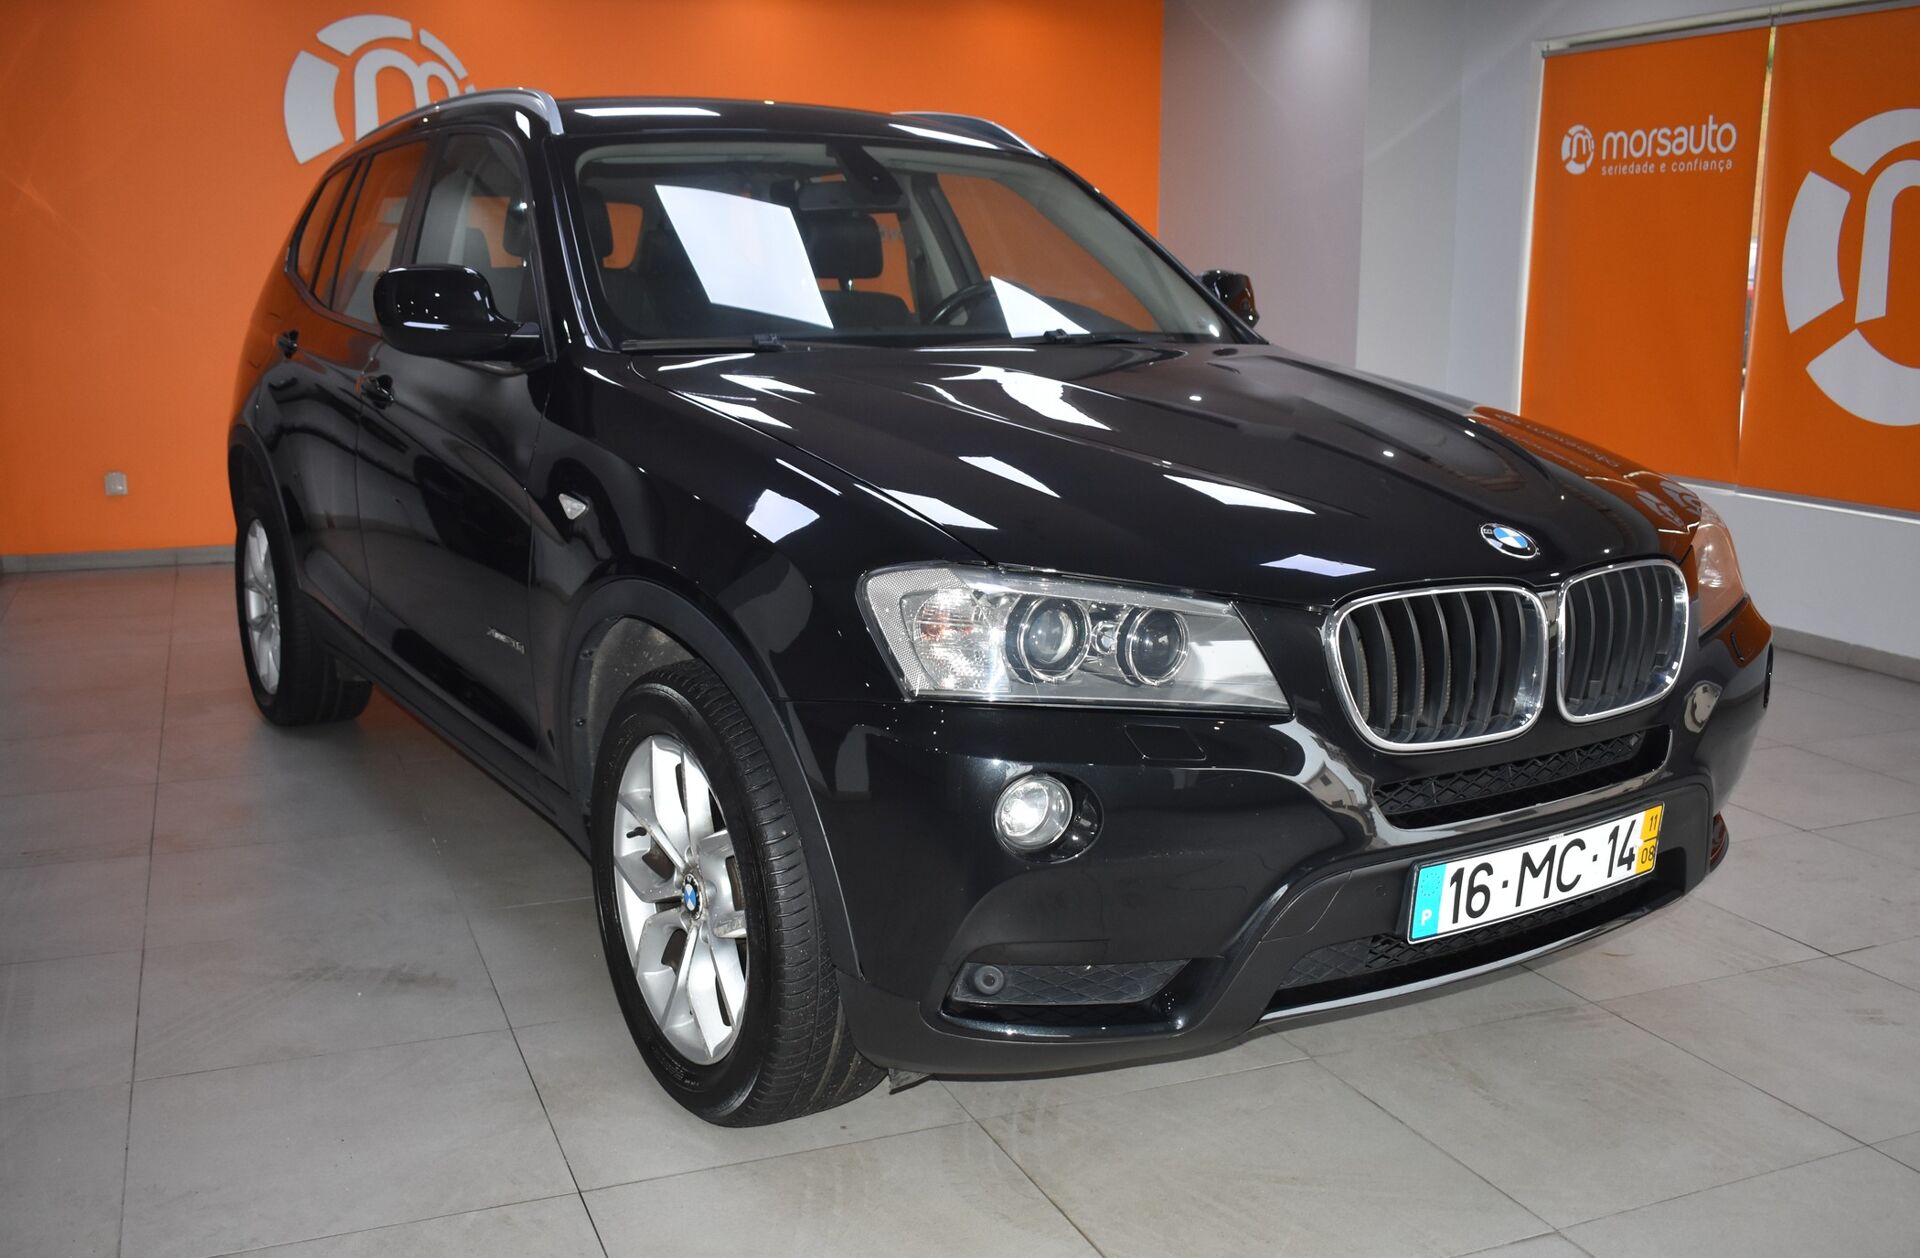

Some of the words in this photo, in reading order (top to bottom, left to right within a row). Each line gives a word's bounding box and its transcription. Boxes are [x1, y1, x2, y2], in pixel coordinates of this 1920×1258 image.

[1602, 114, 1737, 160] morsauto
[1601, 161, 1655, 175] seriedade
[1660, 163, 1667, 173] e
[1672, 158, 1733, 173] confiança
[1649, 815, 1658, 832] 11
[1640, 845, 1655, 864] 08
[1420, 909, 1433, 927] P
